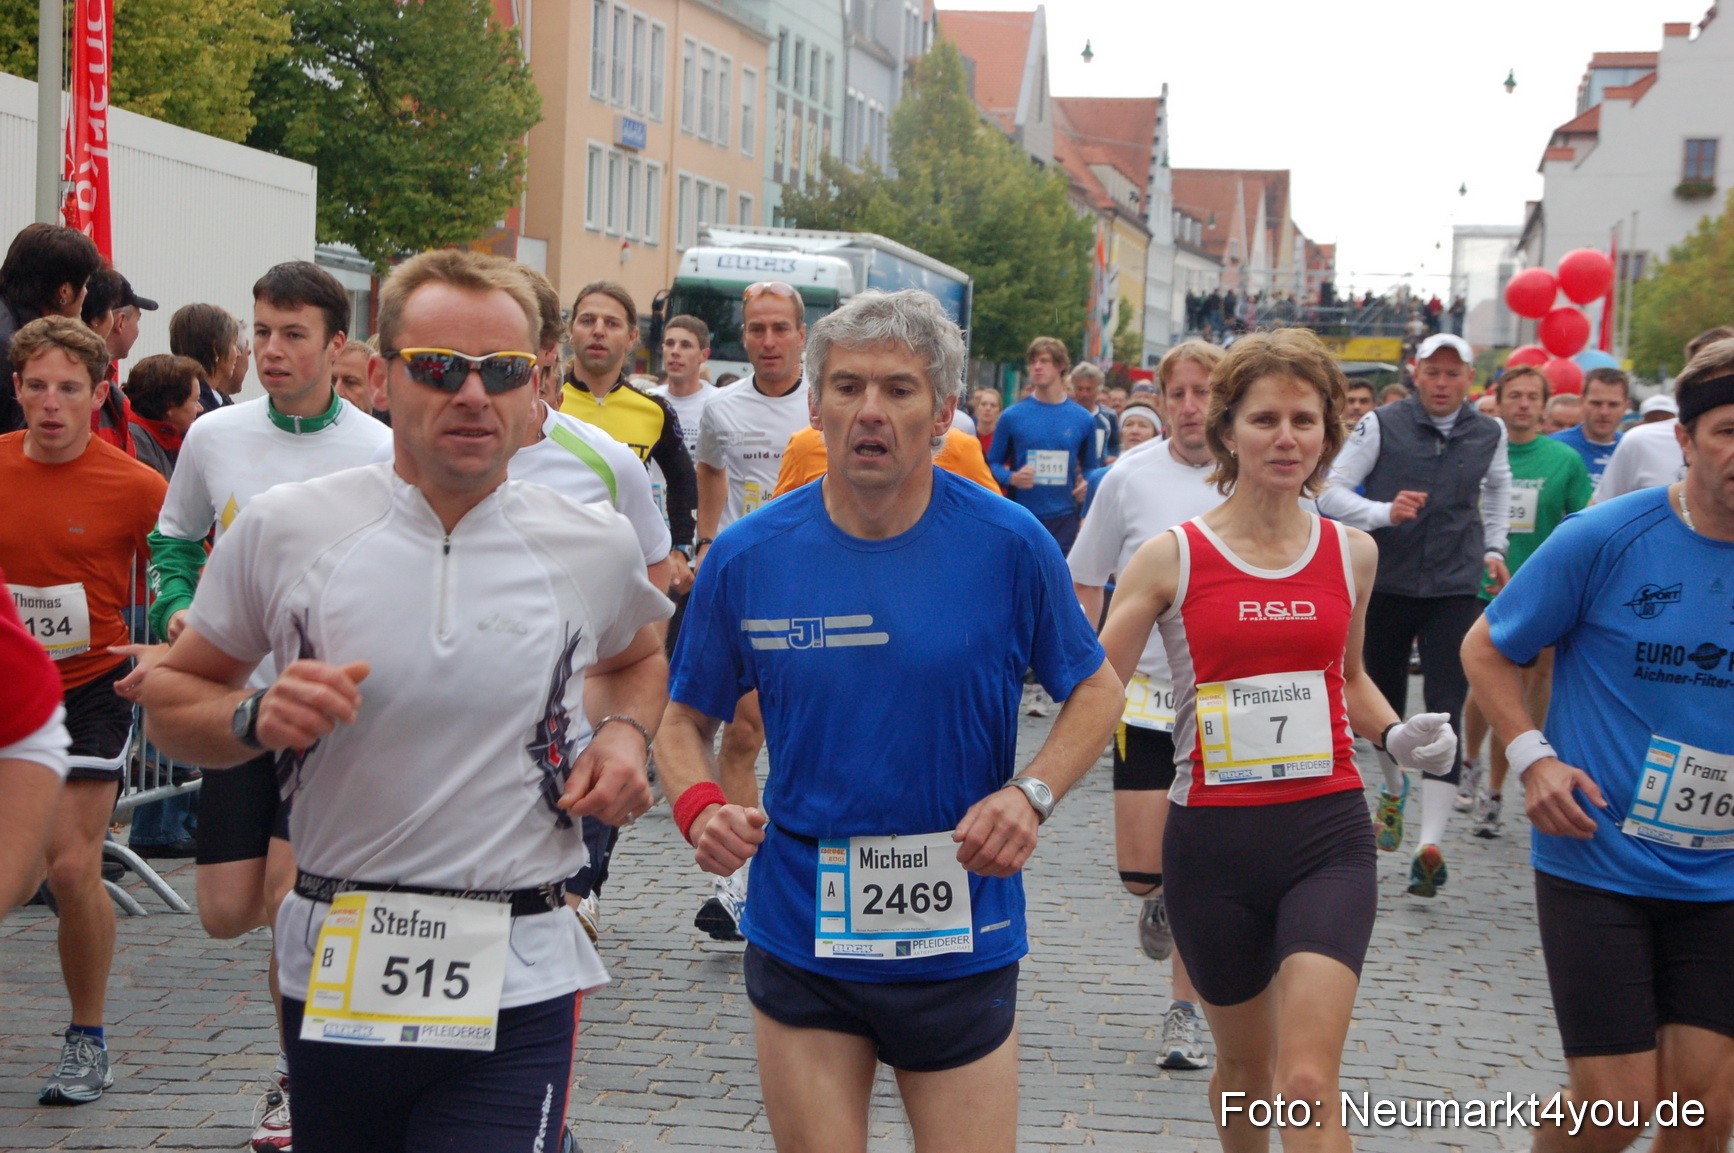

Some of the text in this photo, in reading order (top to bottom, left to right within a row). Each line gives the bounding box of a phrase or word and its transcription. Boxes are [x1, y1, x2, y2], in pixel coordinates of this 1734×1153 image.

[717, 254, 796, 273] BOCK
[743, 451, 769, 459] wild
[1040, 464, 1063, 473] 3111
[13, 593, 62, 609] Thomas
[1239, 601, 1316, 617] R&D
[24, 616, 72, 637] 134
[1635, 642, 1685, 667] EURO
[1233, 682, 1311, 707] Franziska
[1204, 720, 1213, 735] B
[1270, 715, 1288, 743] 7
[1286, 760, 1331, 771] PFLEIDERER
[1683, 755, 1728, 782] Franz
[1646, 775, 1656, 790] B
[859, 845, 928, 869] Michael
[827, 881, 836, 897] A
[862, 880, 953, 915] 2469
[371, 907, 446, 940] Stefan
[832, 943, 873, 952] BOCK
[912, 935, 970, 950] PFLEIDERER
[321, 947, 334, 968] B
[381, 955, 470, 1000] 515
[421, 1025, 491, 1041] PFLEIDERER
